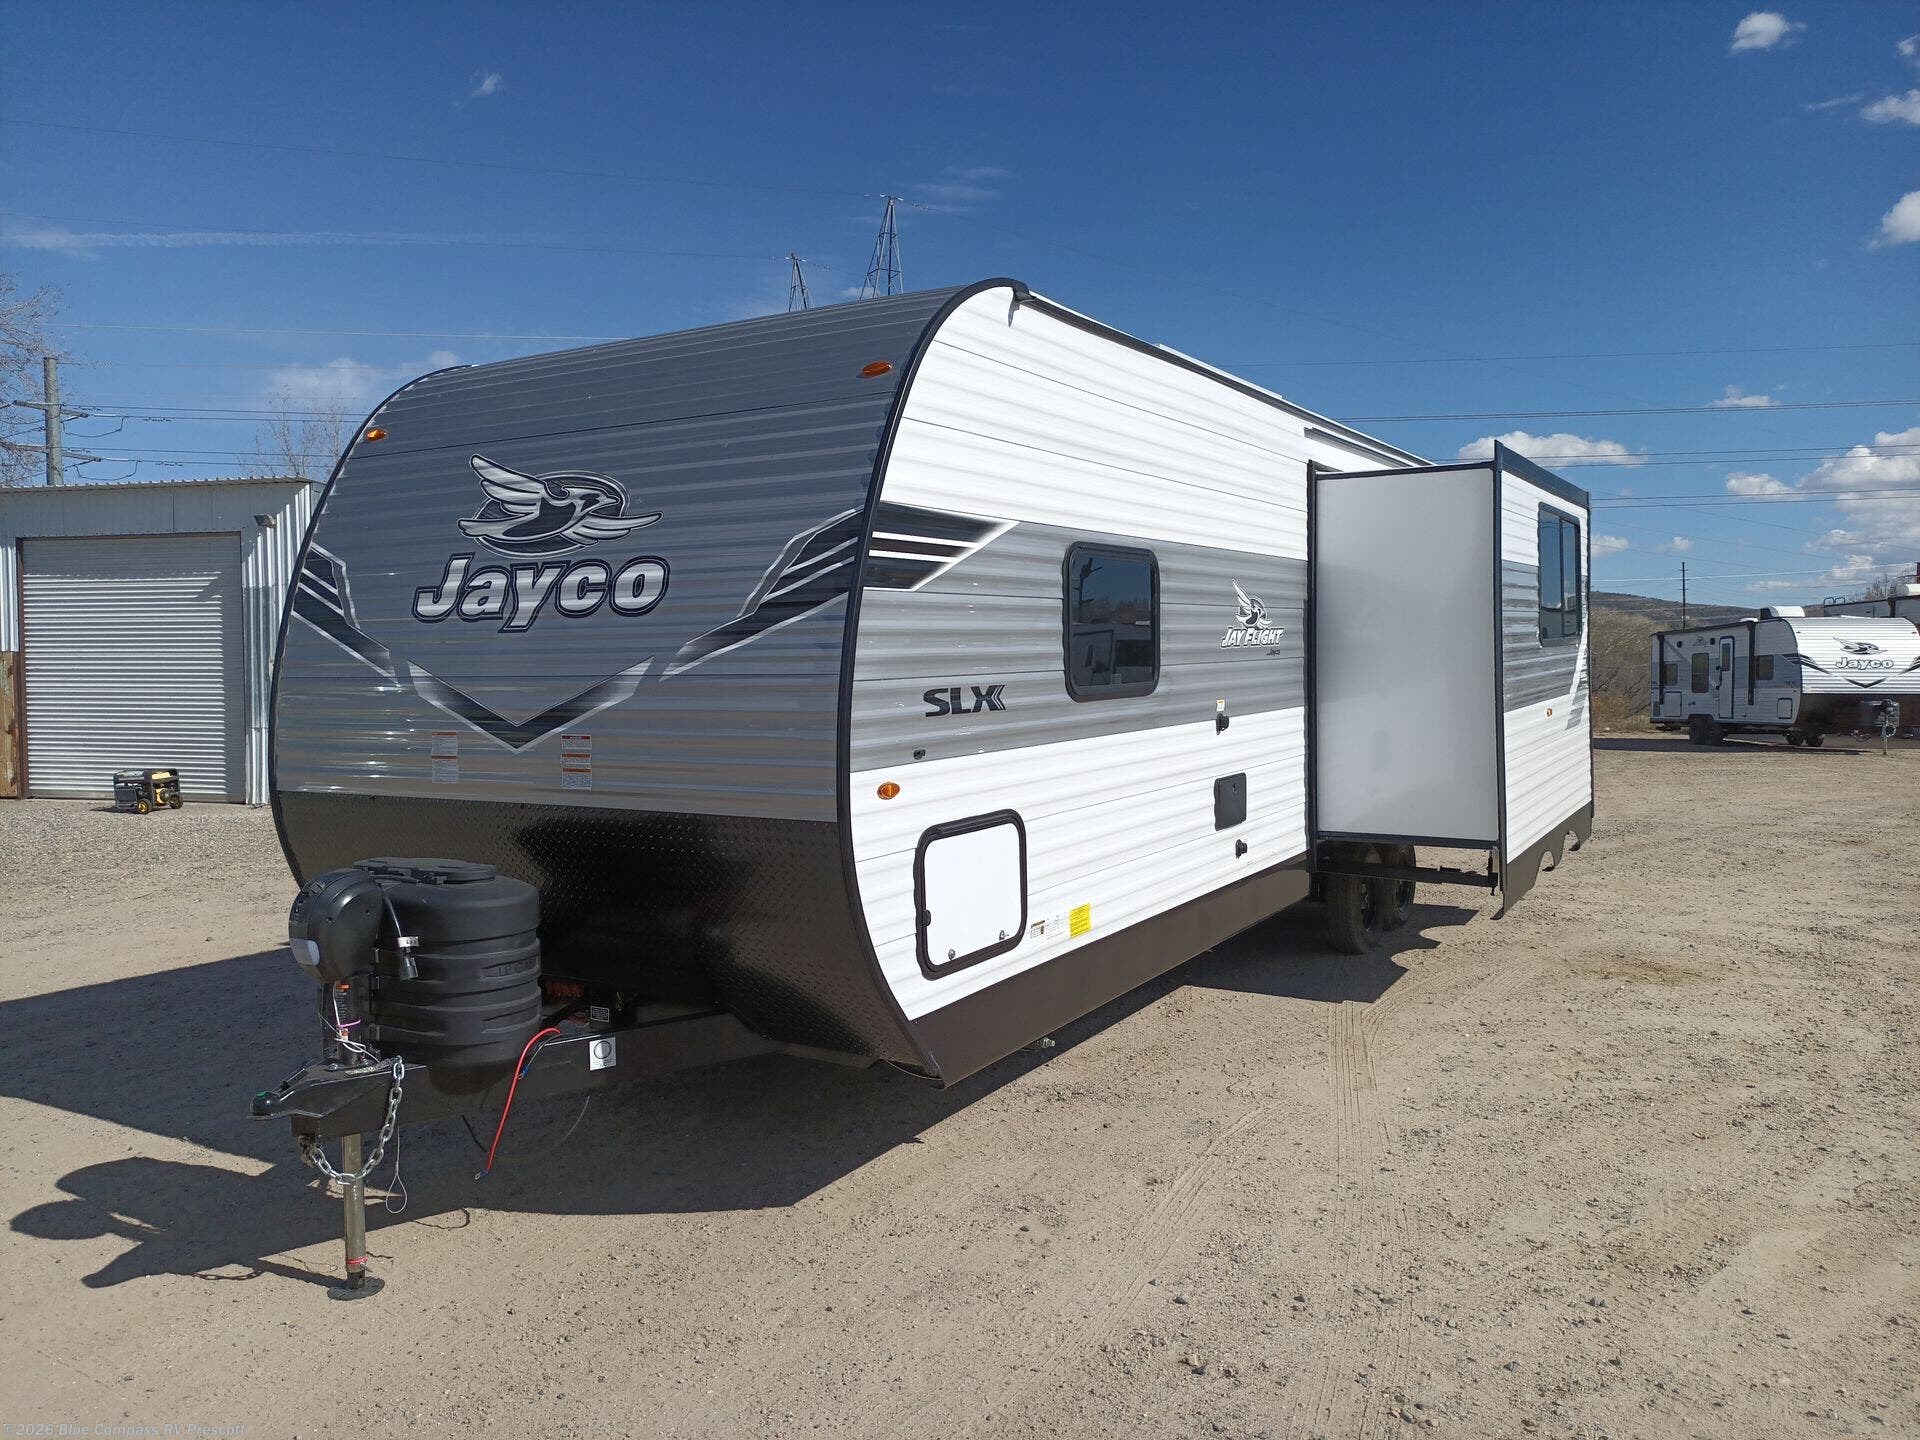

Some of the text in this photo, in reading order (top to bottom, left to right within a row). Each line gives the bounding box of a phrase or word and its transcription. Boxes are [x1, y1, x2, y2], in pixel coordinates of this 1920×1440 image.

[411, 552, 671, 633] Jayco
[1220, 626, 1285, 649] JAY FLIGHT
[1835, 656, 1895, 670] Jayco
[923, 684, 1007, 717] SLX
